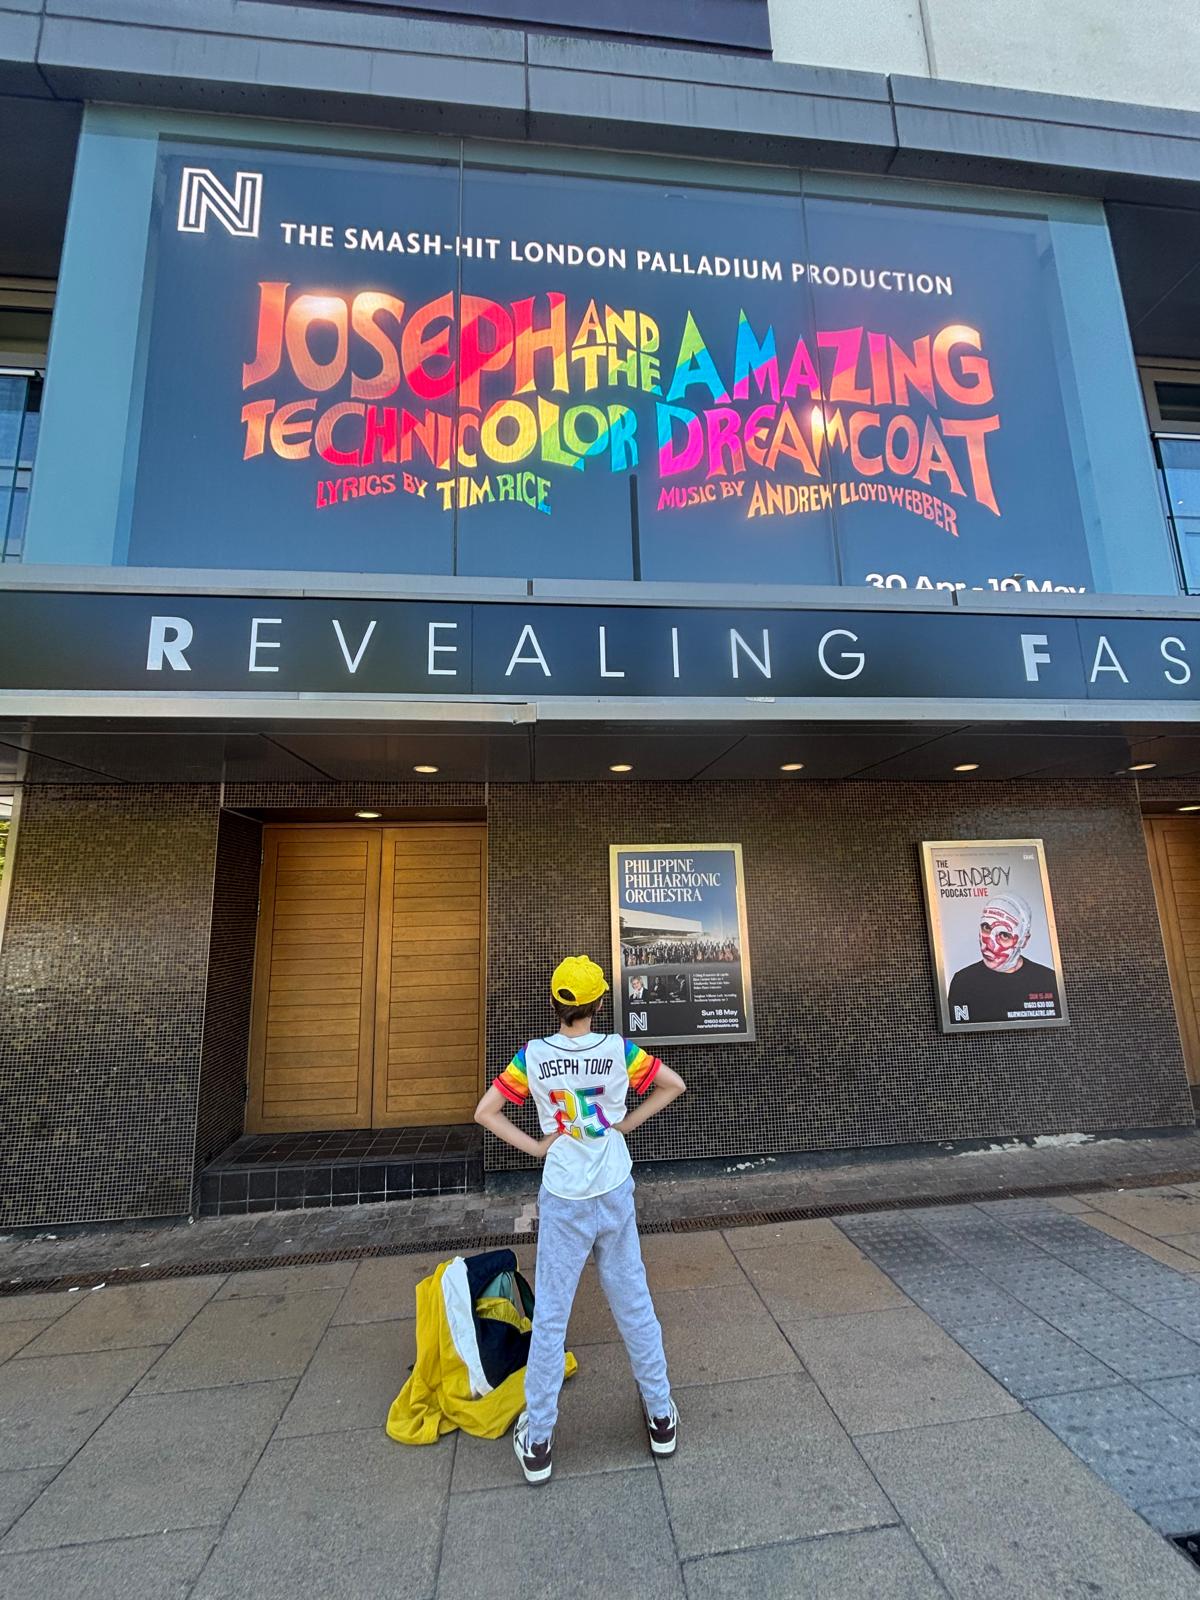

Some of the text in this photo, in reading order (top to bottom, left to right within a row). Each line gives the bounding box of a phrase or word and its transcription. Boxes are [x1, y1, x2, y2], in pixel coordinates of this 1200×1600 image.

[280, 222, 954, 296] THE SMASH-HIT LONDON PALLADIUM PRODUCTION
[242, 281, 994, 411] JOSEPH AND THE AMAZING
[240, 395, 1001, 517] TECHNICOLOR DREAMCOAT
[316, 472, 552, 516] LYRICS BY TIM RICE
[657, 484, 716, 511] MUSIC
[719, 480, 745, 499] BY
[747, 480, 837, 519] ANDREW
[886, 484, 959, 538] WEBBER
[146, 616, 1192, 685] REVEALING FAS
[624, 858, 695, 874] PHILIPPINE
[936, 859, 949, 869] THE
[938, 866, 1011, 888] BLINDBOY
[625, 873, 721, 889] PHILHARMONIC
[625, 888, 703, 904] ORCHESTRA
[940, 887, 989, 898] PODCAST LIVE
[538, 1058, 613, 1080] JOSEPH TOUR
[549, 1086, 611, 1140] 25
